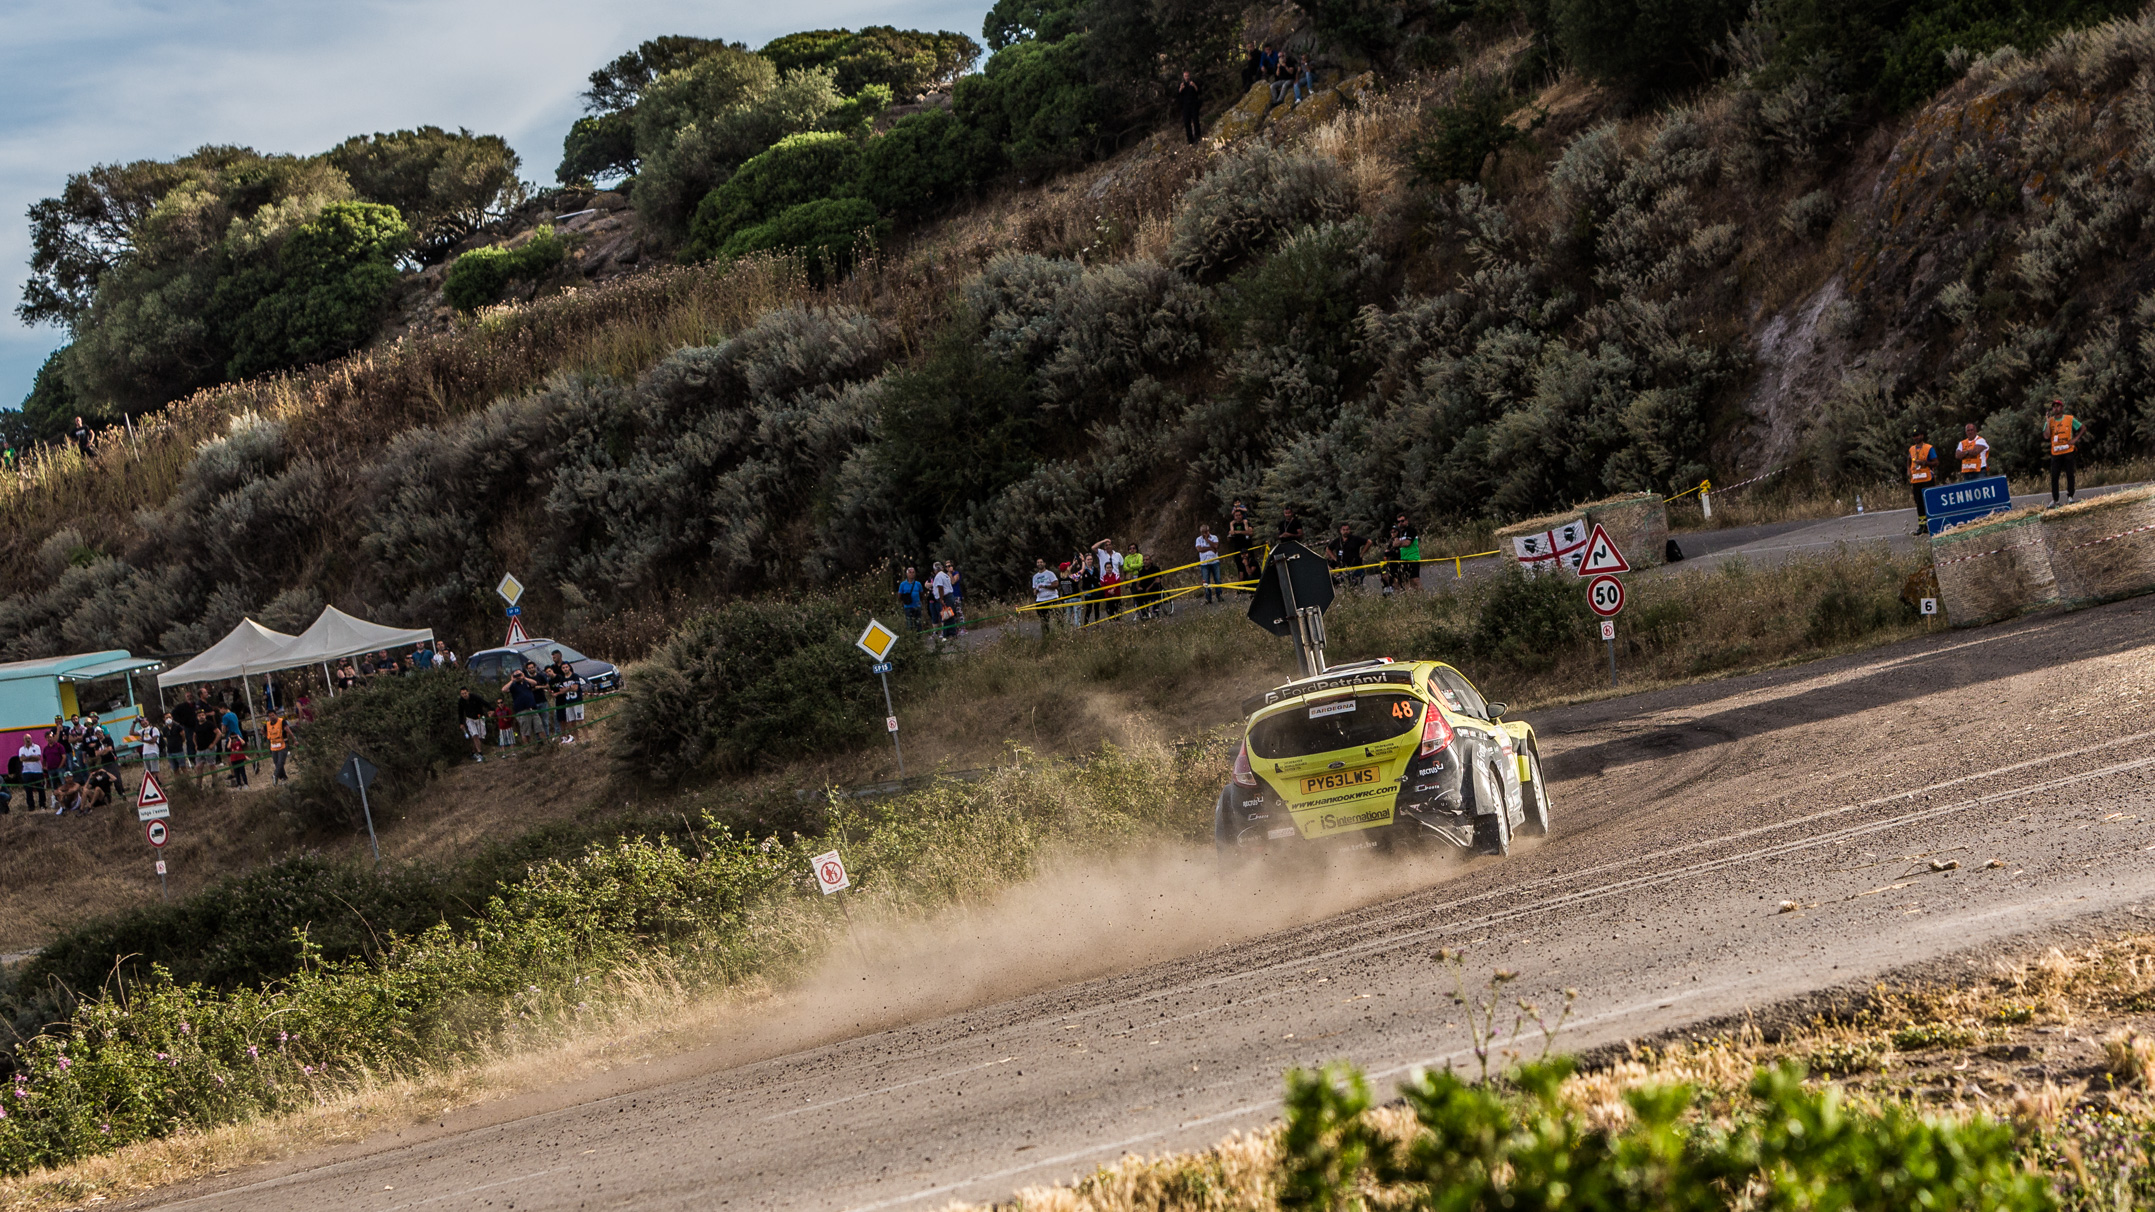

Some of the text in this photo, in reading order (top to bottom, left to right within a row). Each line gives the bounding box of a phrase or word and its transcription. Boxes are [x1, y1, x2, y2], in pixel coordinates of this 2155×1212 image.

[1940, 485, 1996, 506] SENNORI
[1595, 585, 1618, 605] 50
[1925, 601, 1933, 611] 6
[1281, 672, 1388, 697] FordPetrányi
[1391, 701, 1414, 719] 48
[1307, 768, 1374, 792] PY63LWS
